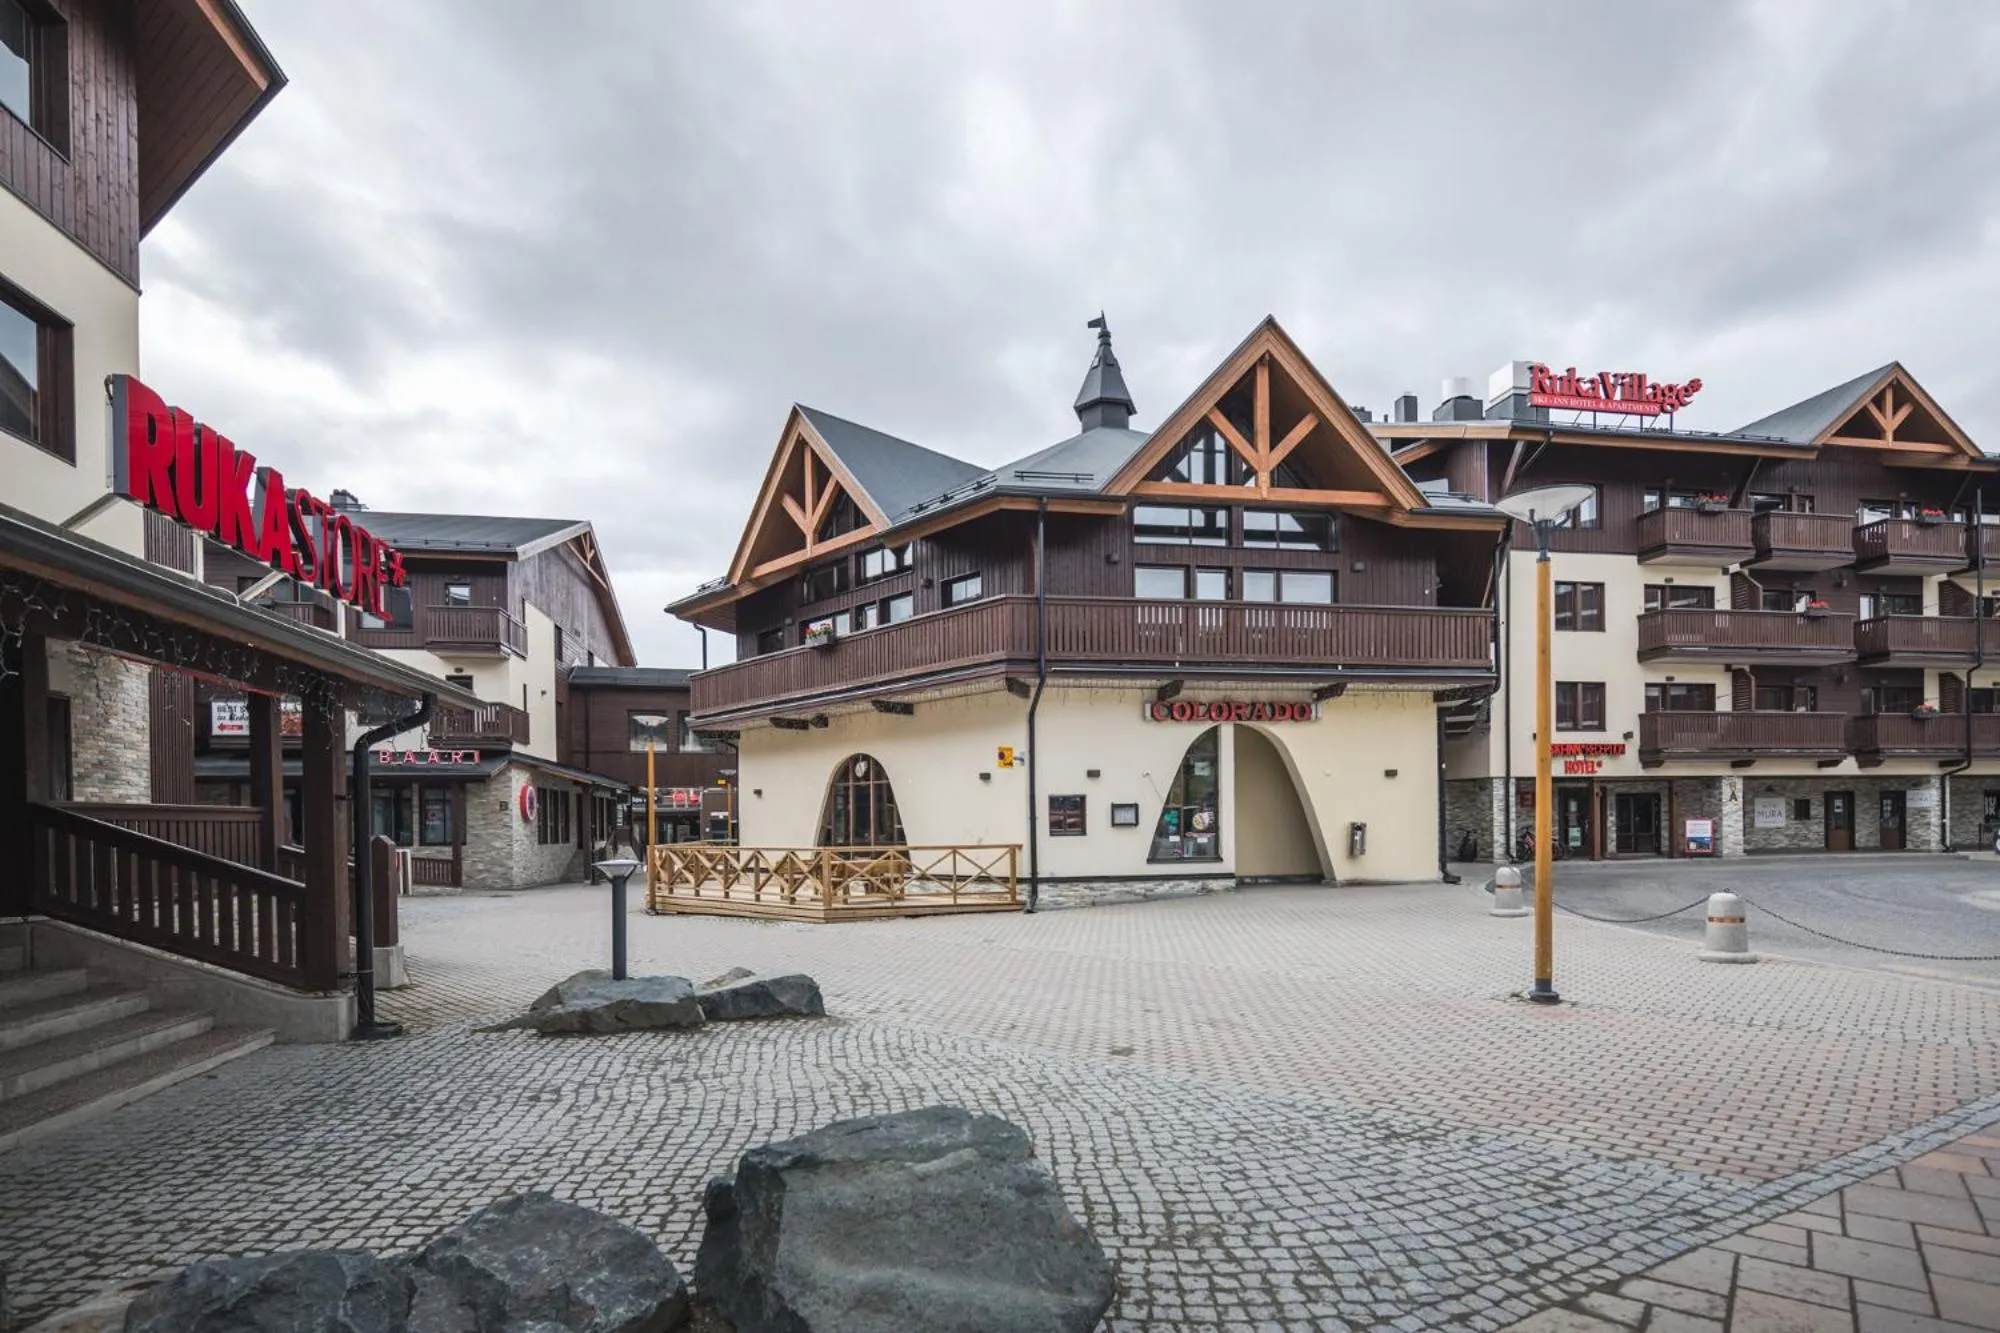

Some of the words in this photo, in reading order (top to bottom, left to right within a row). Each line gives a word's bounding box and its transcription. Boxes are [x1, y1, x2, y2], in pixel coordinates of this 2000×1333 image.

[1570, 398, 1597, 408] HOTEL
[1607, 402, 1660, 413] APARTMENTS
[1152, 702, 1313, 722] COLORADO
[379, 749, 481, 765] BAARI
[1564, 760, 1597, 775] HOTEL
